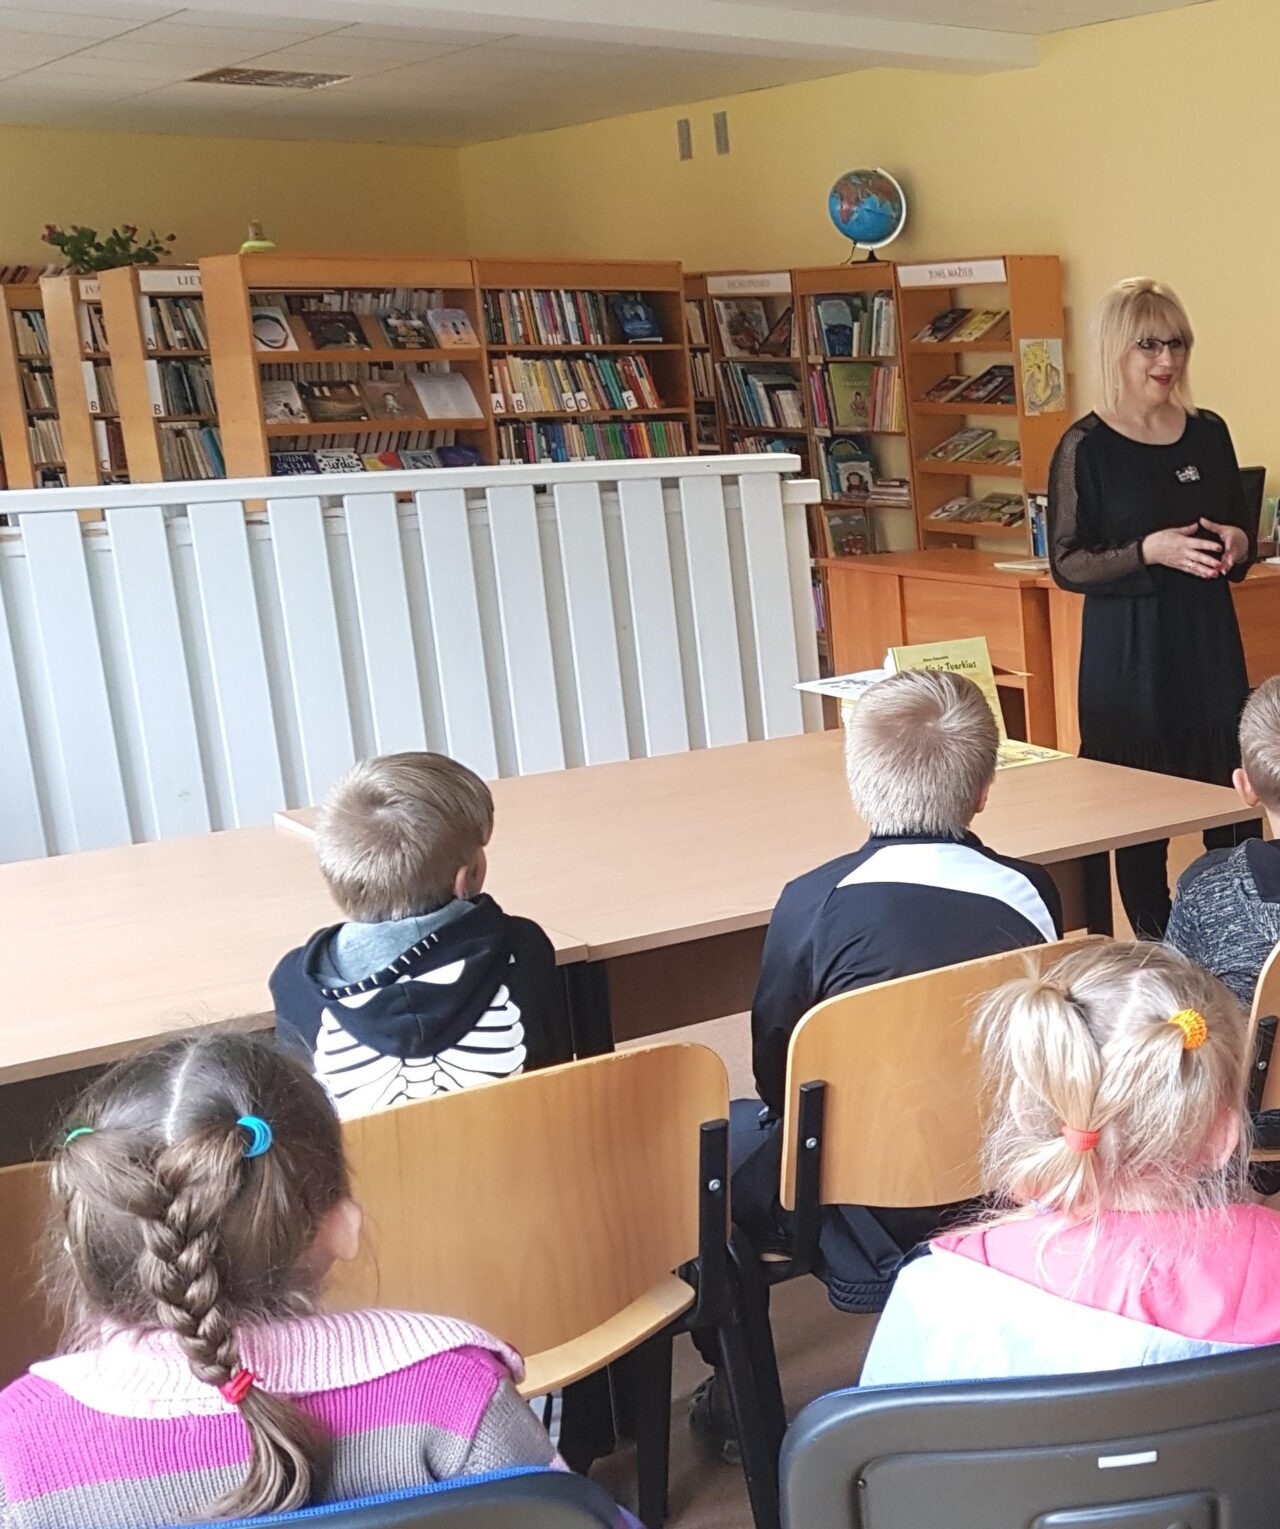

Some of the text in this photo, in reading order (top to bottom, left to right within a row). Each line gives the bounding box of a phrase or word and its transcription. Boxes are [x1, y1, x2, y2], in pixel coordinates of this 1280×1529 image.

[146, 337, 156, 347] A
[91, 400, 98, 411] B
[516, 401, 524, 410] B
[565, 397, 575, 408] C
[578, 398, 588, 408] D
[626, 396, 634, 406] F
[153, 404, 162, 414] B
[494, 402, 503, 411] A
[945, 660, 977, 671] Tvarkius
